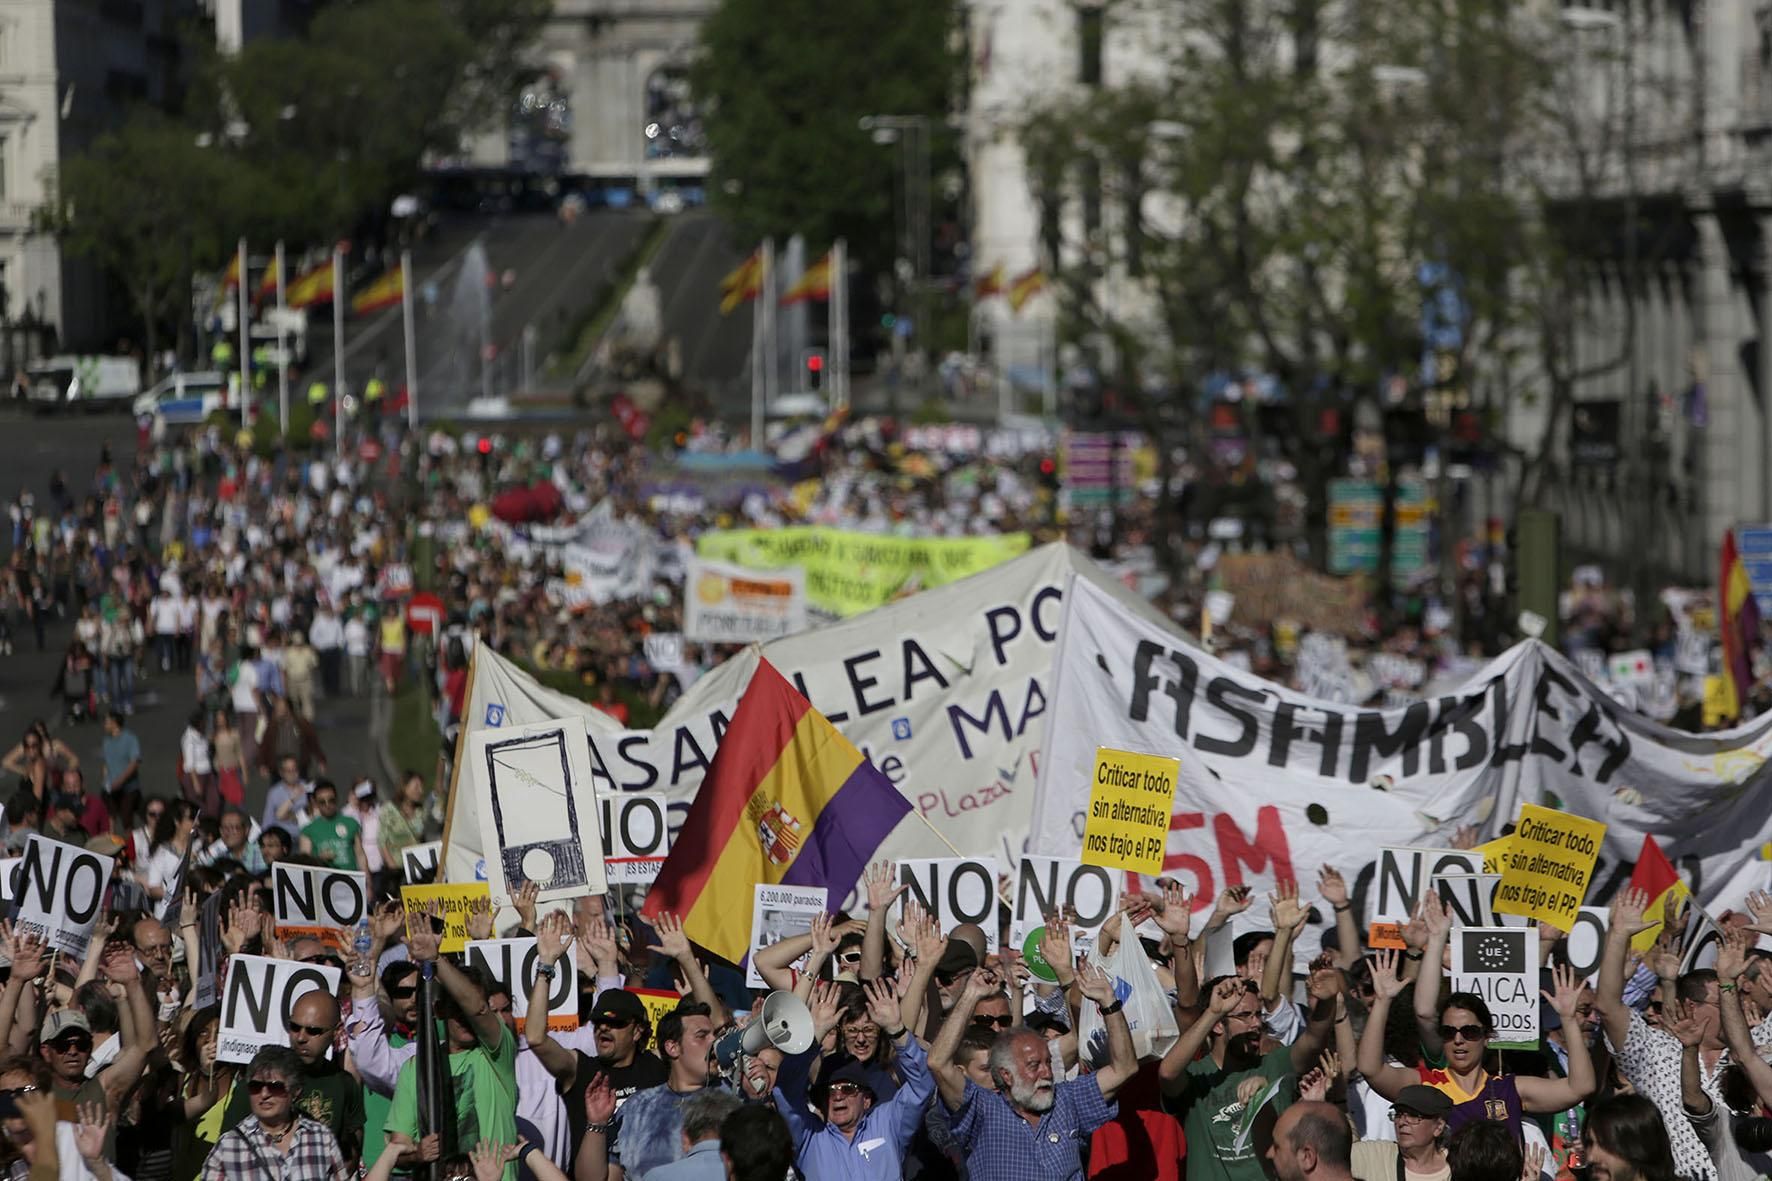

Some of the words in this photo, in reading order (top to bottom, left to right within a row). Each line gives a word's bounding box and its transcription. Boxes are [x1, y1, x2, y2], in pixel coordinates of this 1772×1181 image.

[1129, 639, 1631, 786] ASAMBLEA
[917, 780, 1013, 818] Plaza
[1098, 762, 1142, 788] Criticar
[1143, 770, 1172, 799] todo,
[1093, 796, 1109, 818] sin
[1111, 799, 1167, 832] alternativa,
[1087, 834, 1107, 852] nos
[1109, 833, 1133, 861] trajo
[1135, 837, 1146, 858] el
[1146, 838, 1161, 862] PP.
[1520, 818, 1565, 847] Criticar
[1565, 830, 1595, 860] todo,
[16, 839, 103, 924] NO
[1510, 849, 1528, 871] sin
[1528, 853, 1584, 890] alternativa,
[276, 868, 363, 926] NO
[760, 890, 793, 904] 6.200.000
[900, 861, 993, 926] NO
[1017, 858, 1112, 928] NO
[1501, 884, 1521, 902] nos
[1521, 884, 1547, 910] trajo
[1547, 891, 1561, 912] el
[1559, 893, 1576, 918] PP.
[1486, 947, 1503, 957] UE
[469, 944, 572, 1011] NO
